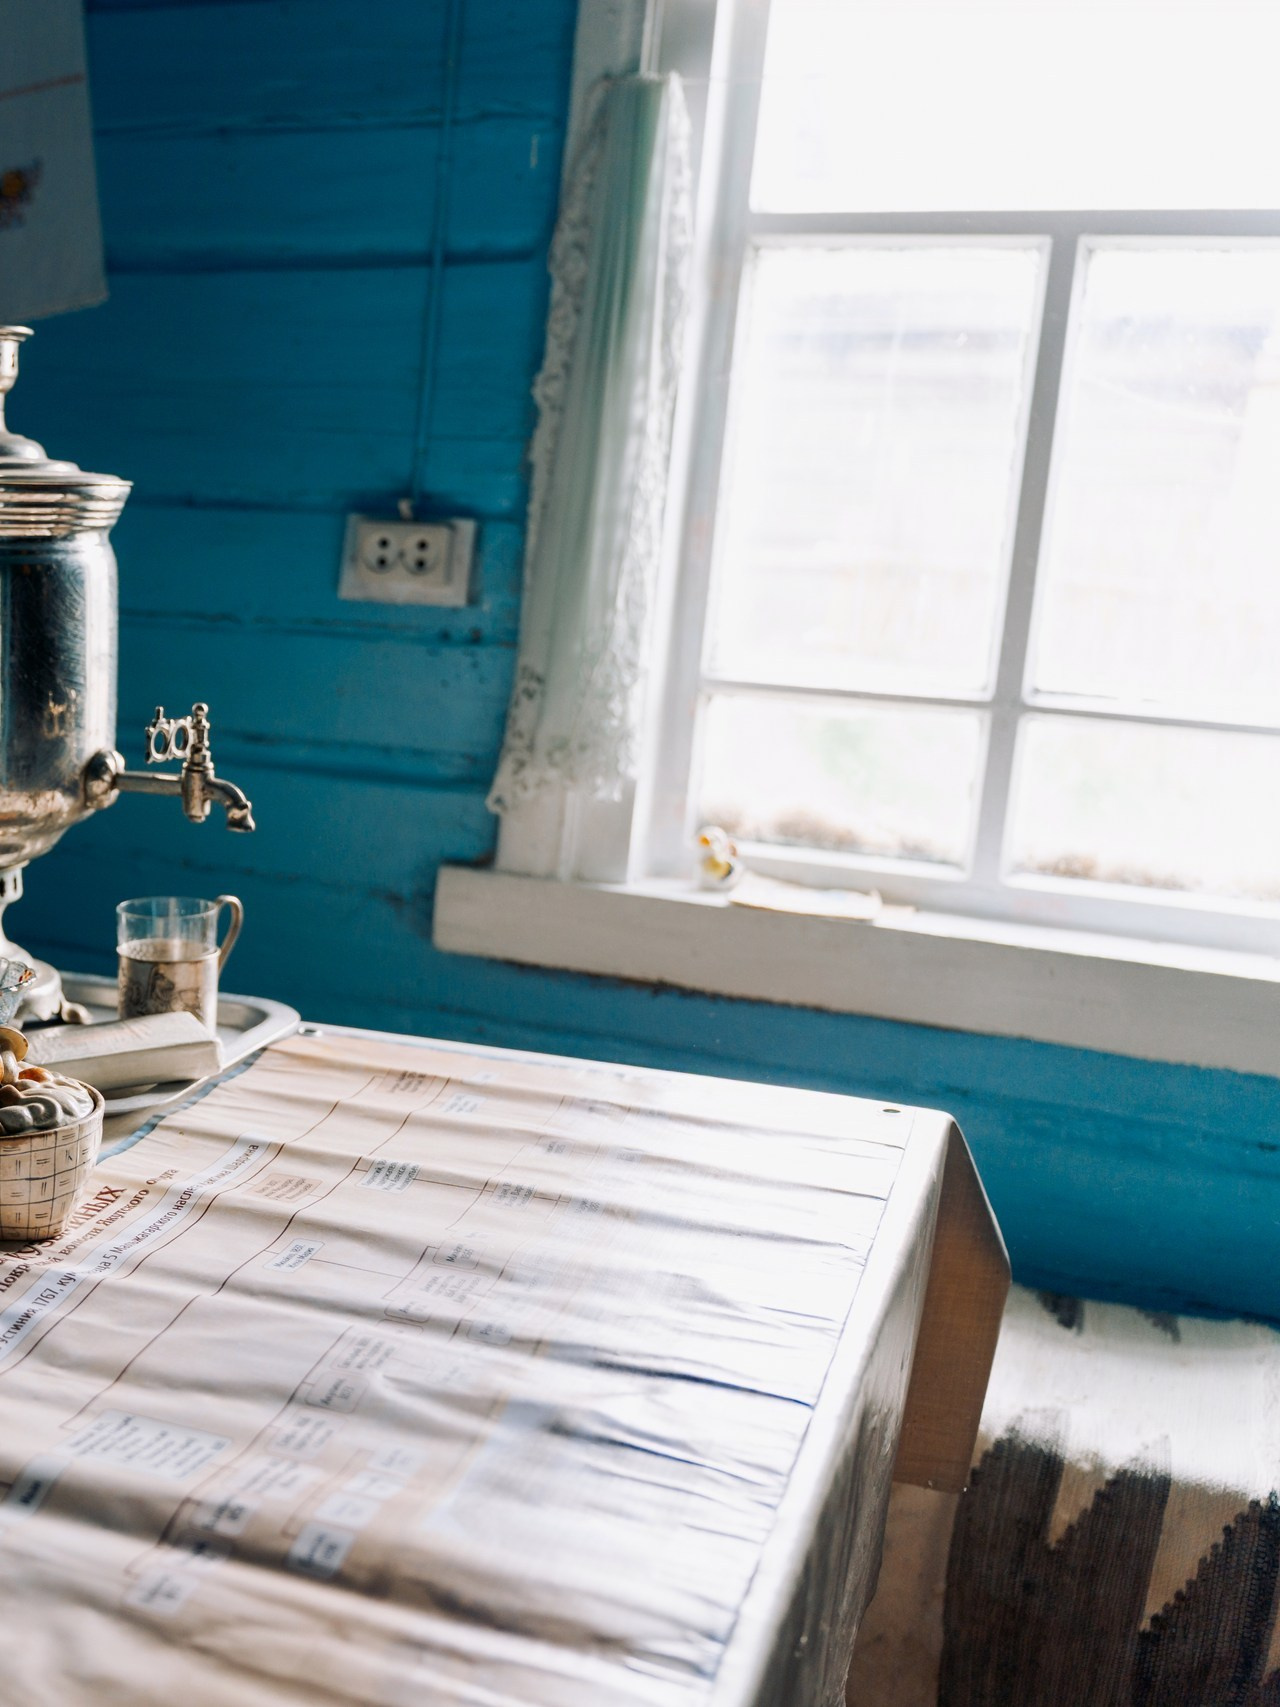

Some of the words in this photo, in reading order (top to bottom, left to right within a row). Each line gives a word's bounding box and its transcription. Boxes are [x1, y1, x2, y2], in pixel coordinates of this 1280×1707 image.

[3, 1186, 127, 1261] Кузьиных
[96, 1189, 150, 1226] Якутского
[146, 1169, 180, 1185] оуга
[172, 1184, 202, 1211] насле
